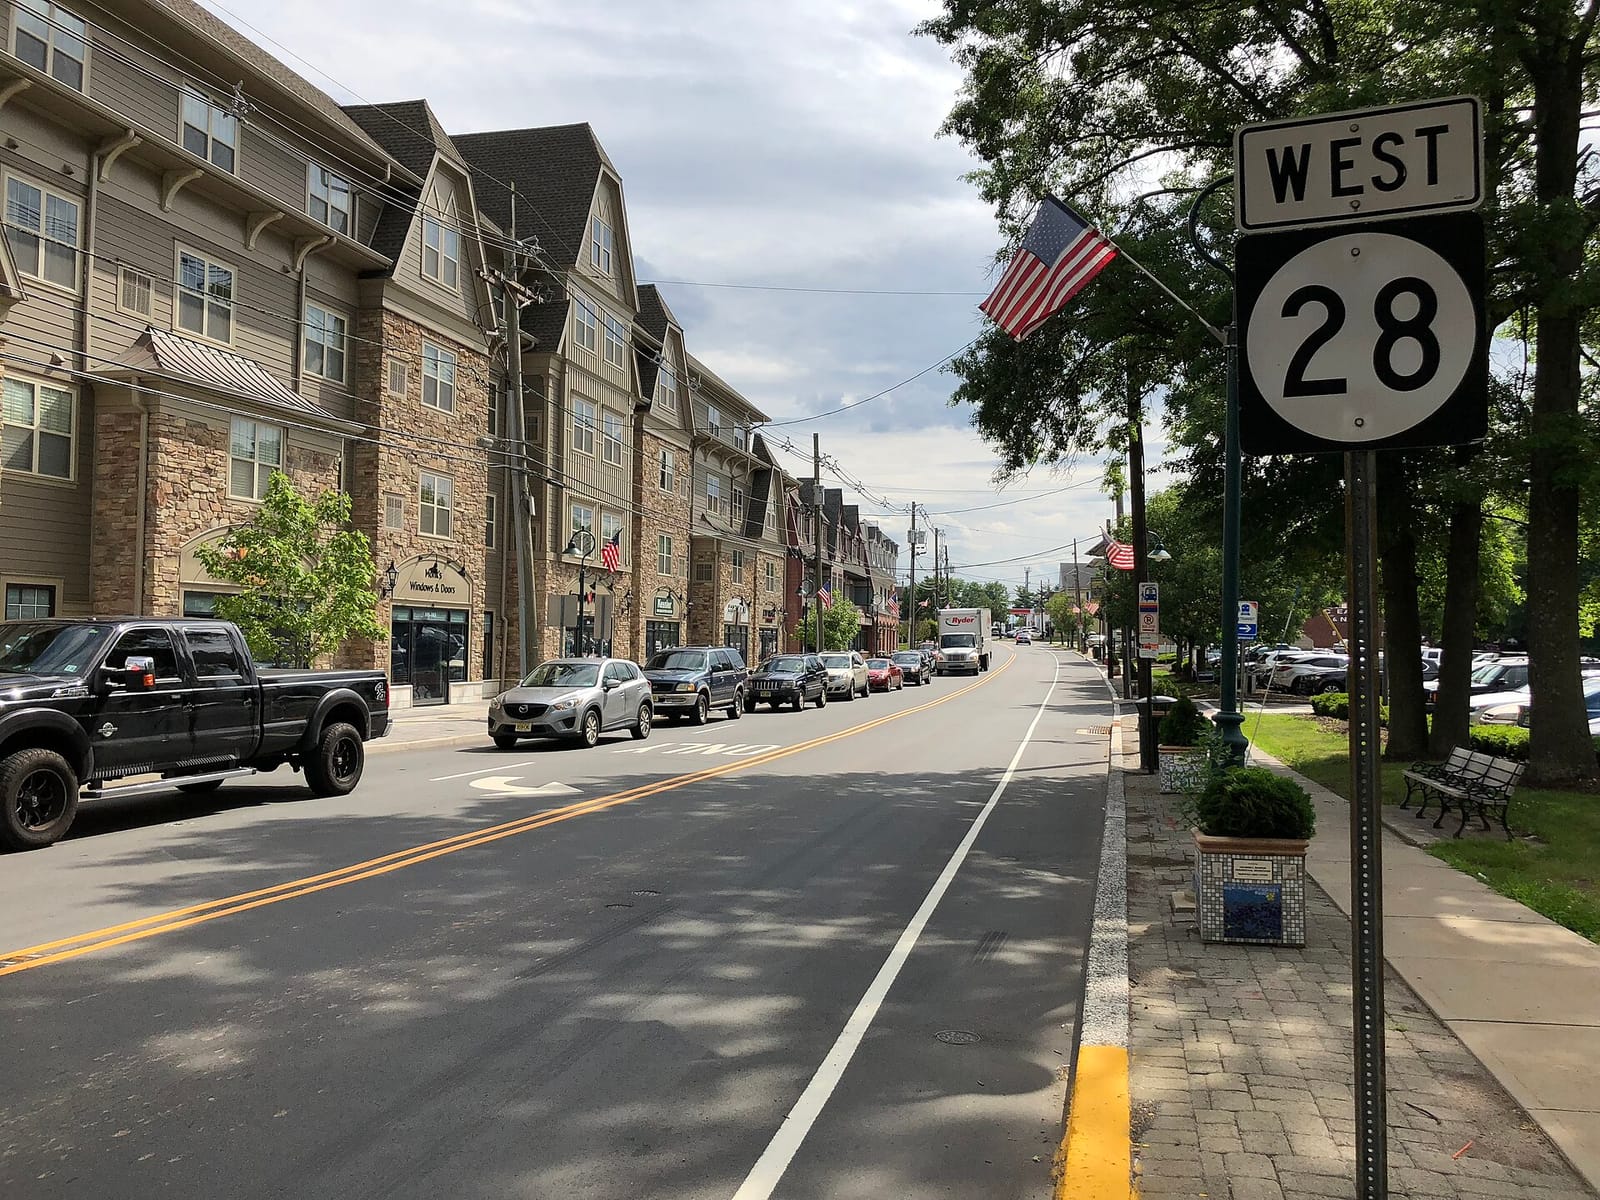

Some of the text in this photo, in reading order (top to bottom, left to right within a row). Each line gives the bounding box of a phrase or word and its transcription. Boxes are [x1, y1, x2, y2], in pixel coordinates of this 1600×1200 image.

[1265, 124, 1450, 203] WEST
[1280, 276, 1441, 398] 28
[410, 582, 456, 594] Windows & Doors
[952, 617, 974, 625] Ryder
[611, 743, 781, 755] ONLY
